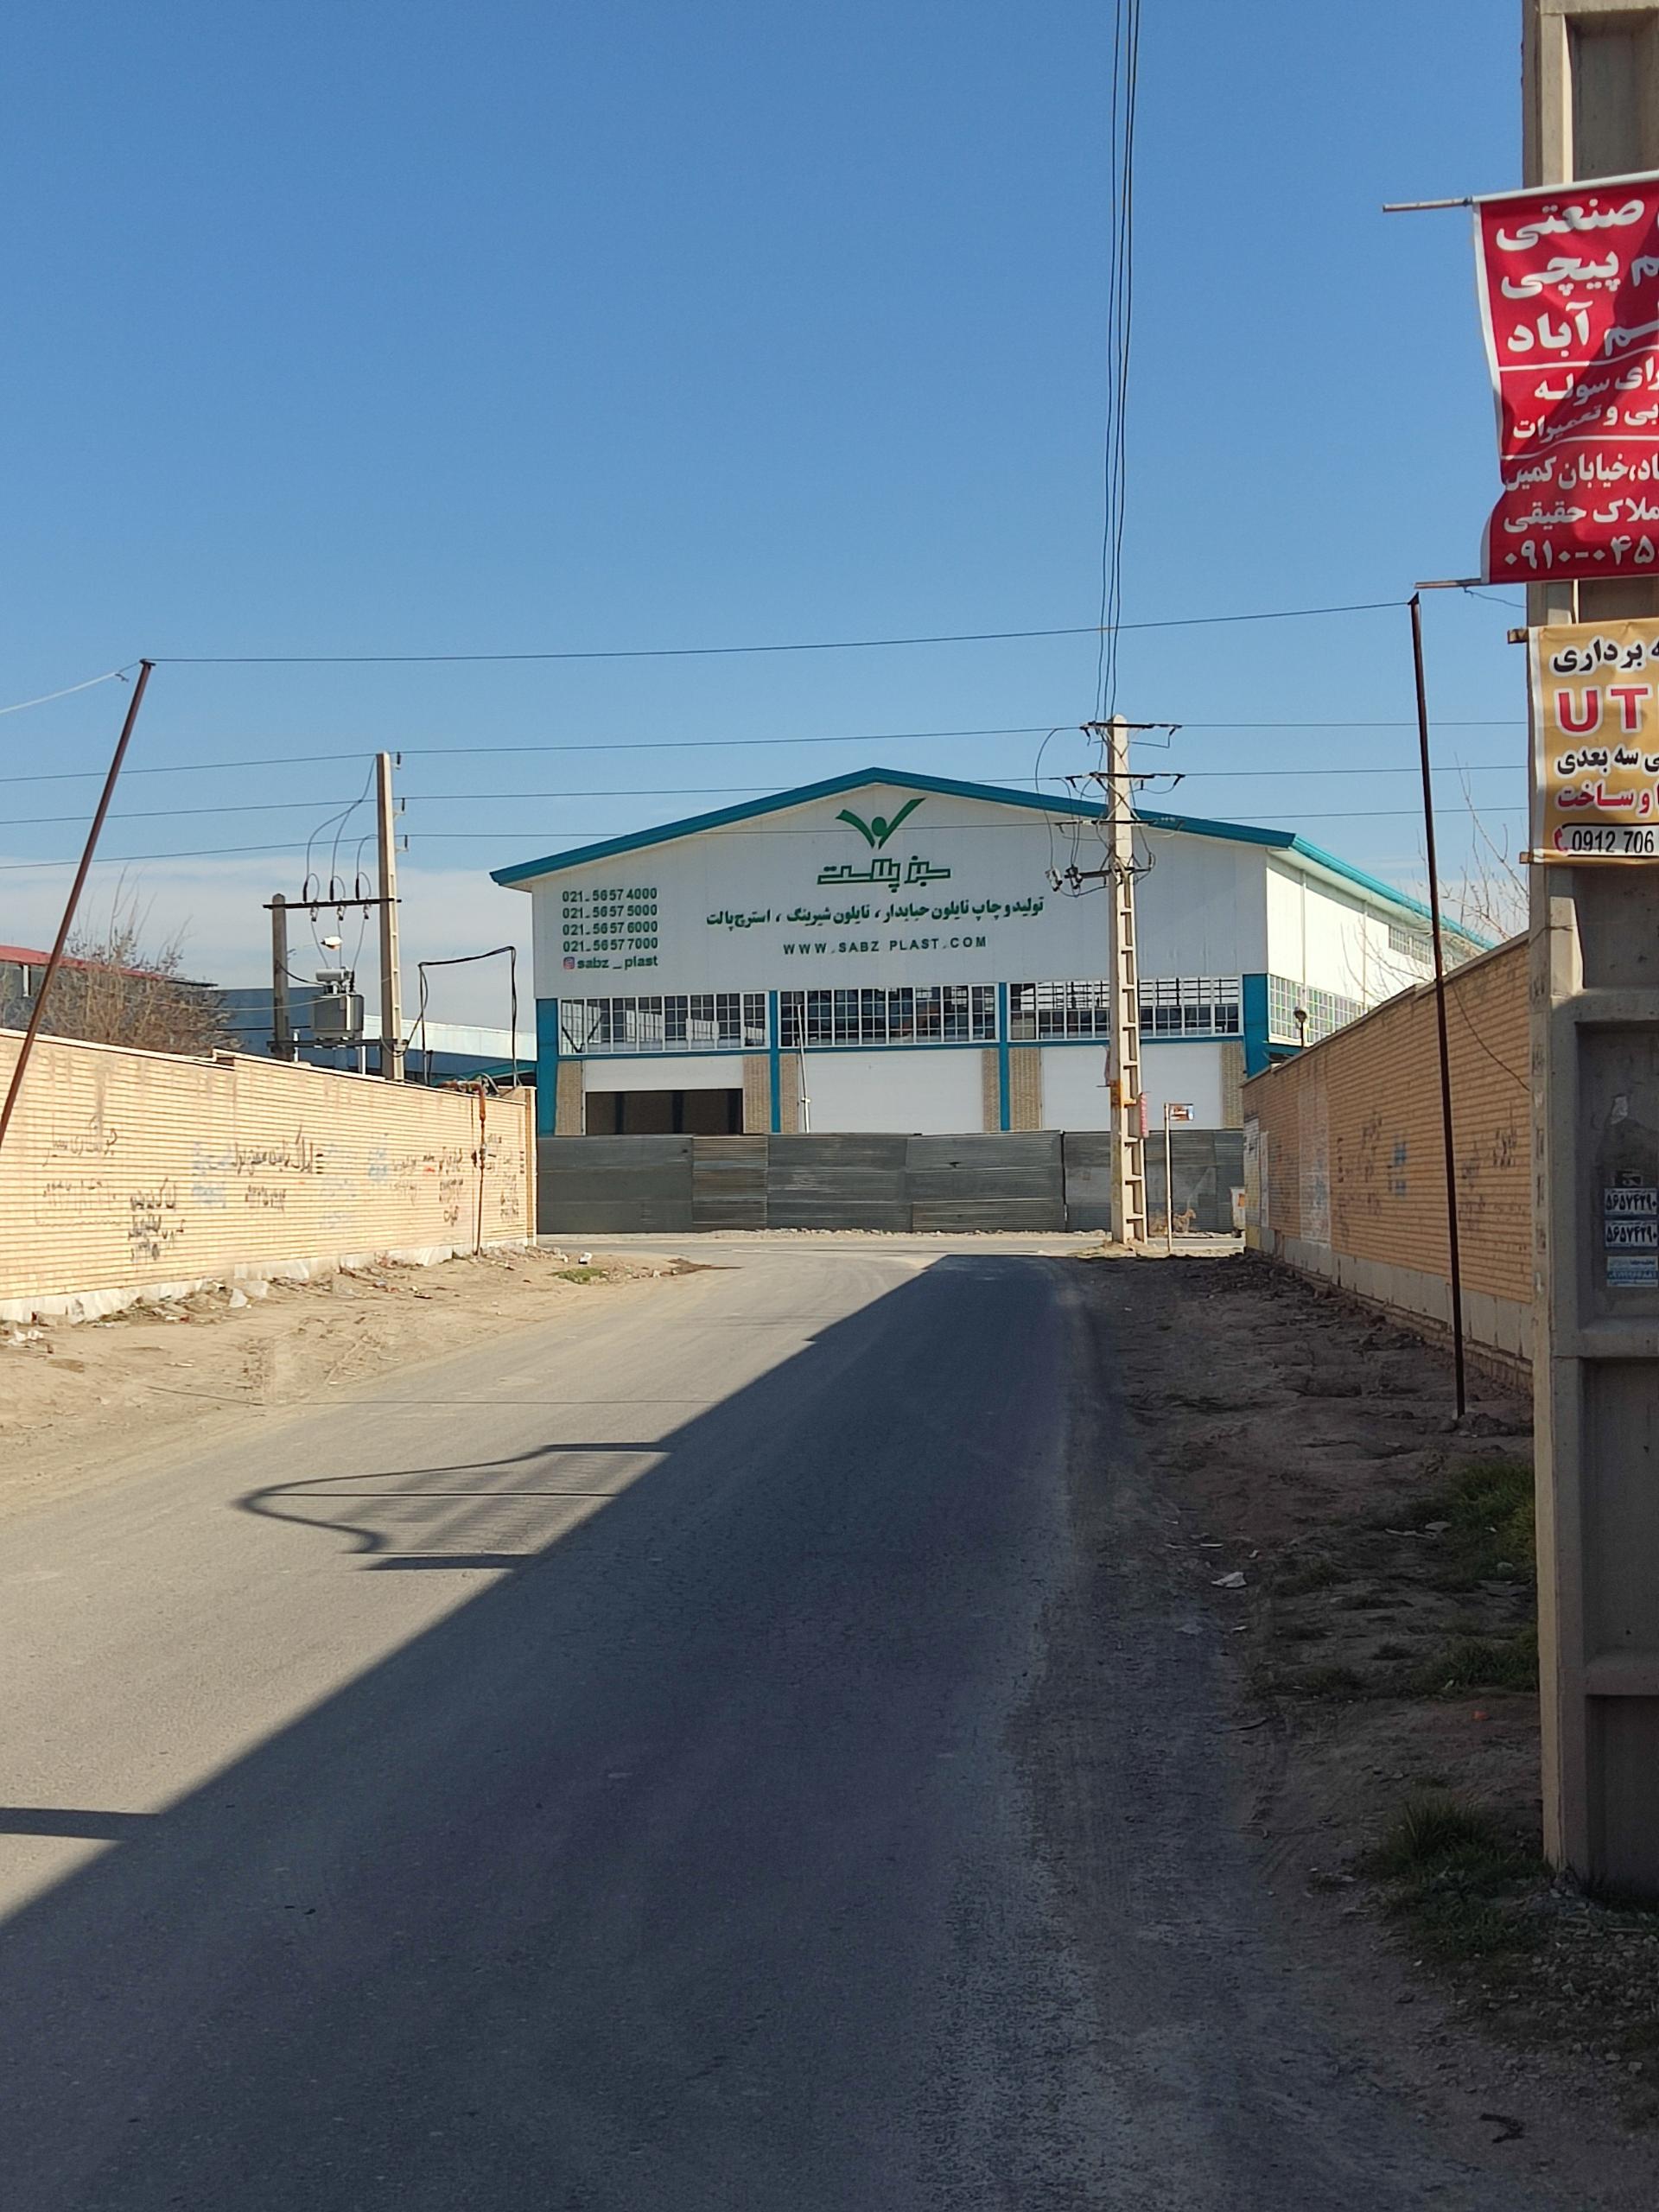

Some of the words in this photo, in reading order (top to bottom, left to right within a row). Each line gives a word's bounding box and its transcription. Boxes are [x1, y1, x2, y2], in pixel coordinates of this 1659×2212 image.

[1497, 199, 1644, 251] صنعتی
[1501, 251, 1621, 299] پیچی
[1508, 301, 1593, 357] آباد
[1615, 356, 1659, 391] رای
[1535, 373, 1610, 406] سوله
[1513, 404, 1602, 442] تعمیرات
[1603, 406, 1618, 425] و
[1624, 403, 1659, 426] بی
[1503, 501, 1587, 533] حقیقی
[1592, 497, 1659, 523] ملاک
[1504, 535, 1656, 569] ۰۹۱۰-۰۴۵
[1554, 639, 1643, 672] برداری
[1558, 688, 1649, 732] UT
[1557, 749, 1608, 774] بعدی
[1614, 747, 1638, 766] سه
[1558, 784, 1633, 808] ساخت
[1639, 792, 1649, 814] و
[1573, 830, 1616, 854] 0912
[1624, 830, 1654, 854] 706
[904, 855, 950, 887] سبز
[834, 904, 869, 925] نایلون
[931, 899, 969, 919] نایلون
[972, 899, 1001, 921] چاپ
[1003, 905, 1011, 918] و
[1012, 897, 1044, 917] تولید
